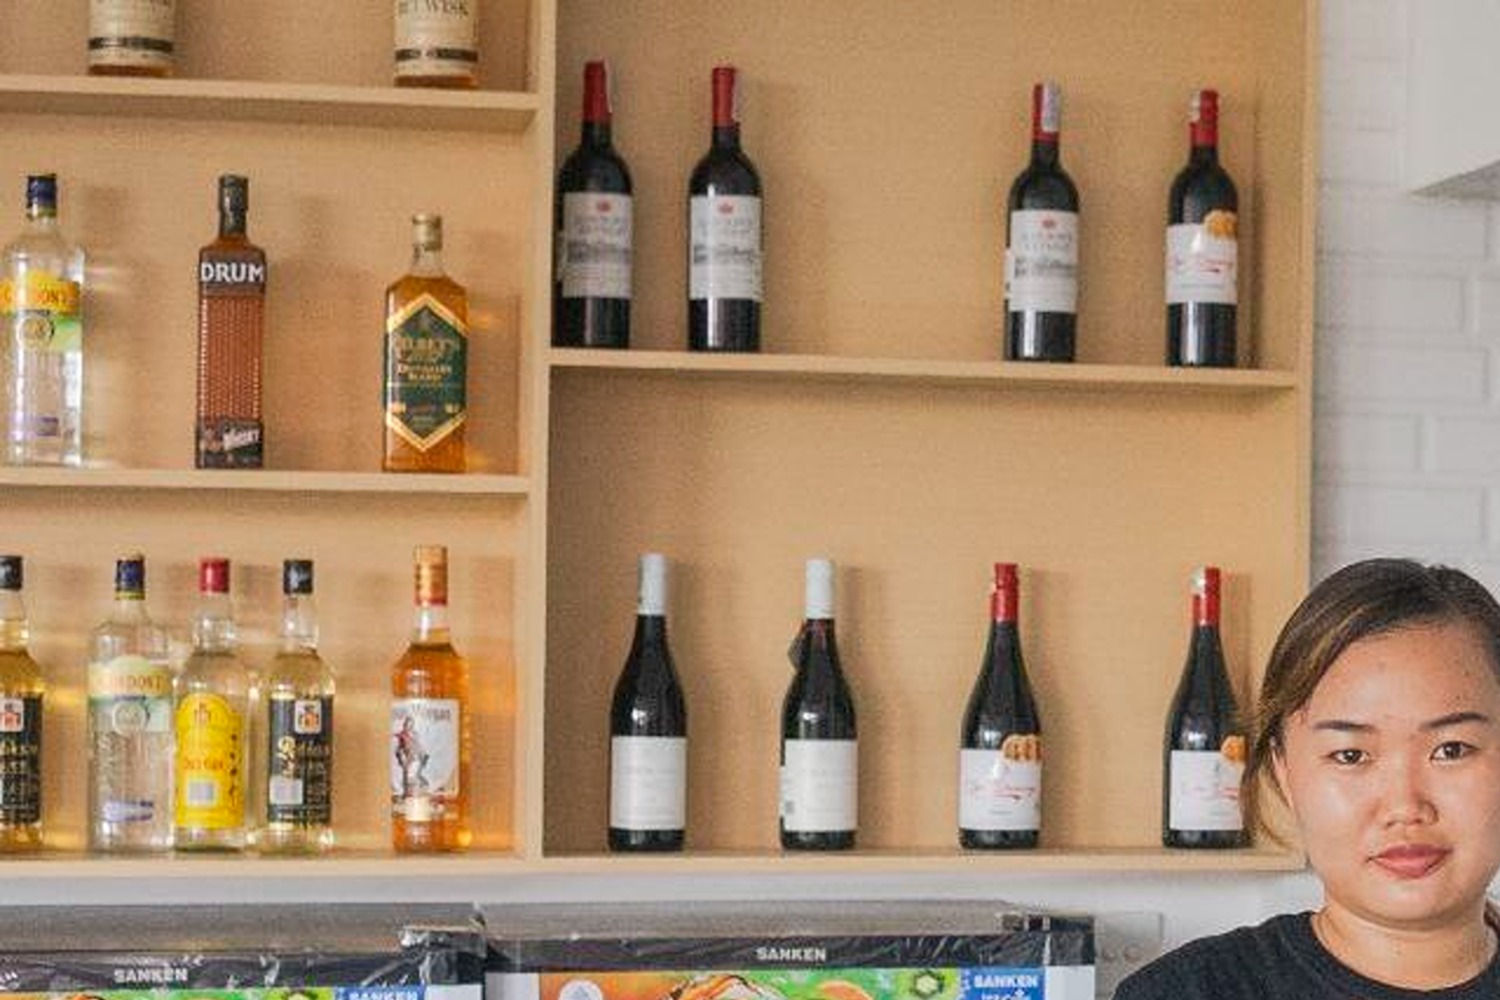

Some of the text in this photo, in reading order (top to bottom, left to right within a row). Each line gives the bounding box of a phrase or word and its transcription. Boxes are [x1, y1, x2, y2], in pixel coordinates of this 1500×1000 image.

[201, 262, 264, 282] DRUM
[755, 946, 827, 962] SANKEN
[113, 967, 189, 983] SANKEN
[974, 974, 1039, 989] SANKEN
